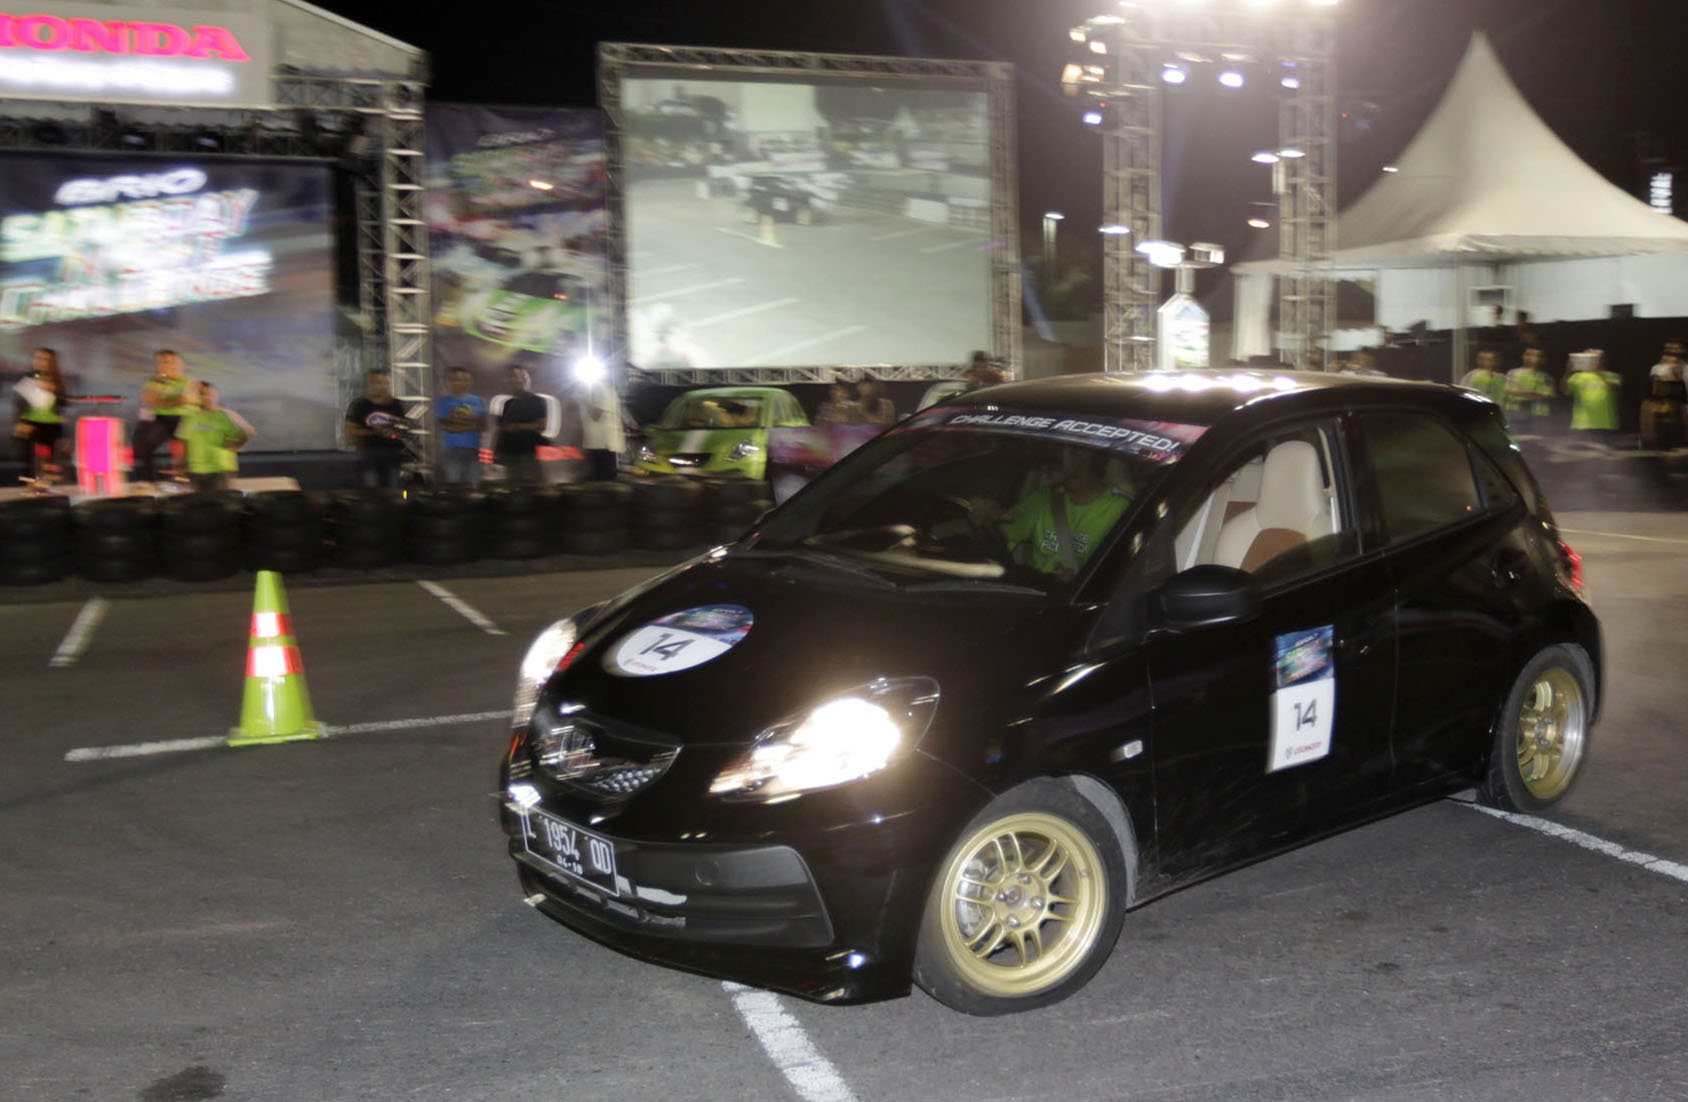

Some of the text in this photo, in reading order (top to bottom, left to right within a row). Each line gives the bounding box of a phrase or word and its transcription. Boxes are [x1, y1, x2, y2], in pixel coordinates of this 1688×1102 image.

[951, 414, 1180, 451] CHALLENGE ACCEPTED!
[639, 632, 696, 661] 14
[1294, 698, 1318, 731] 14
[543, 818, 580, 861] 1954
